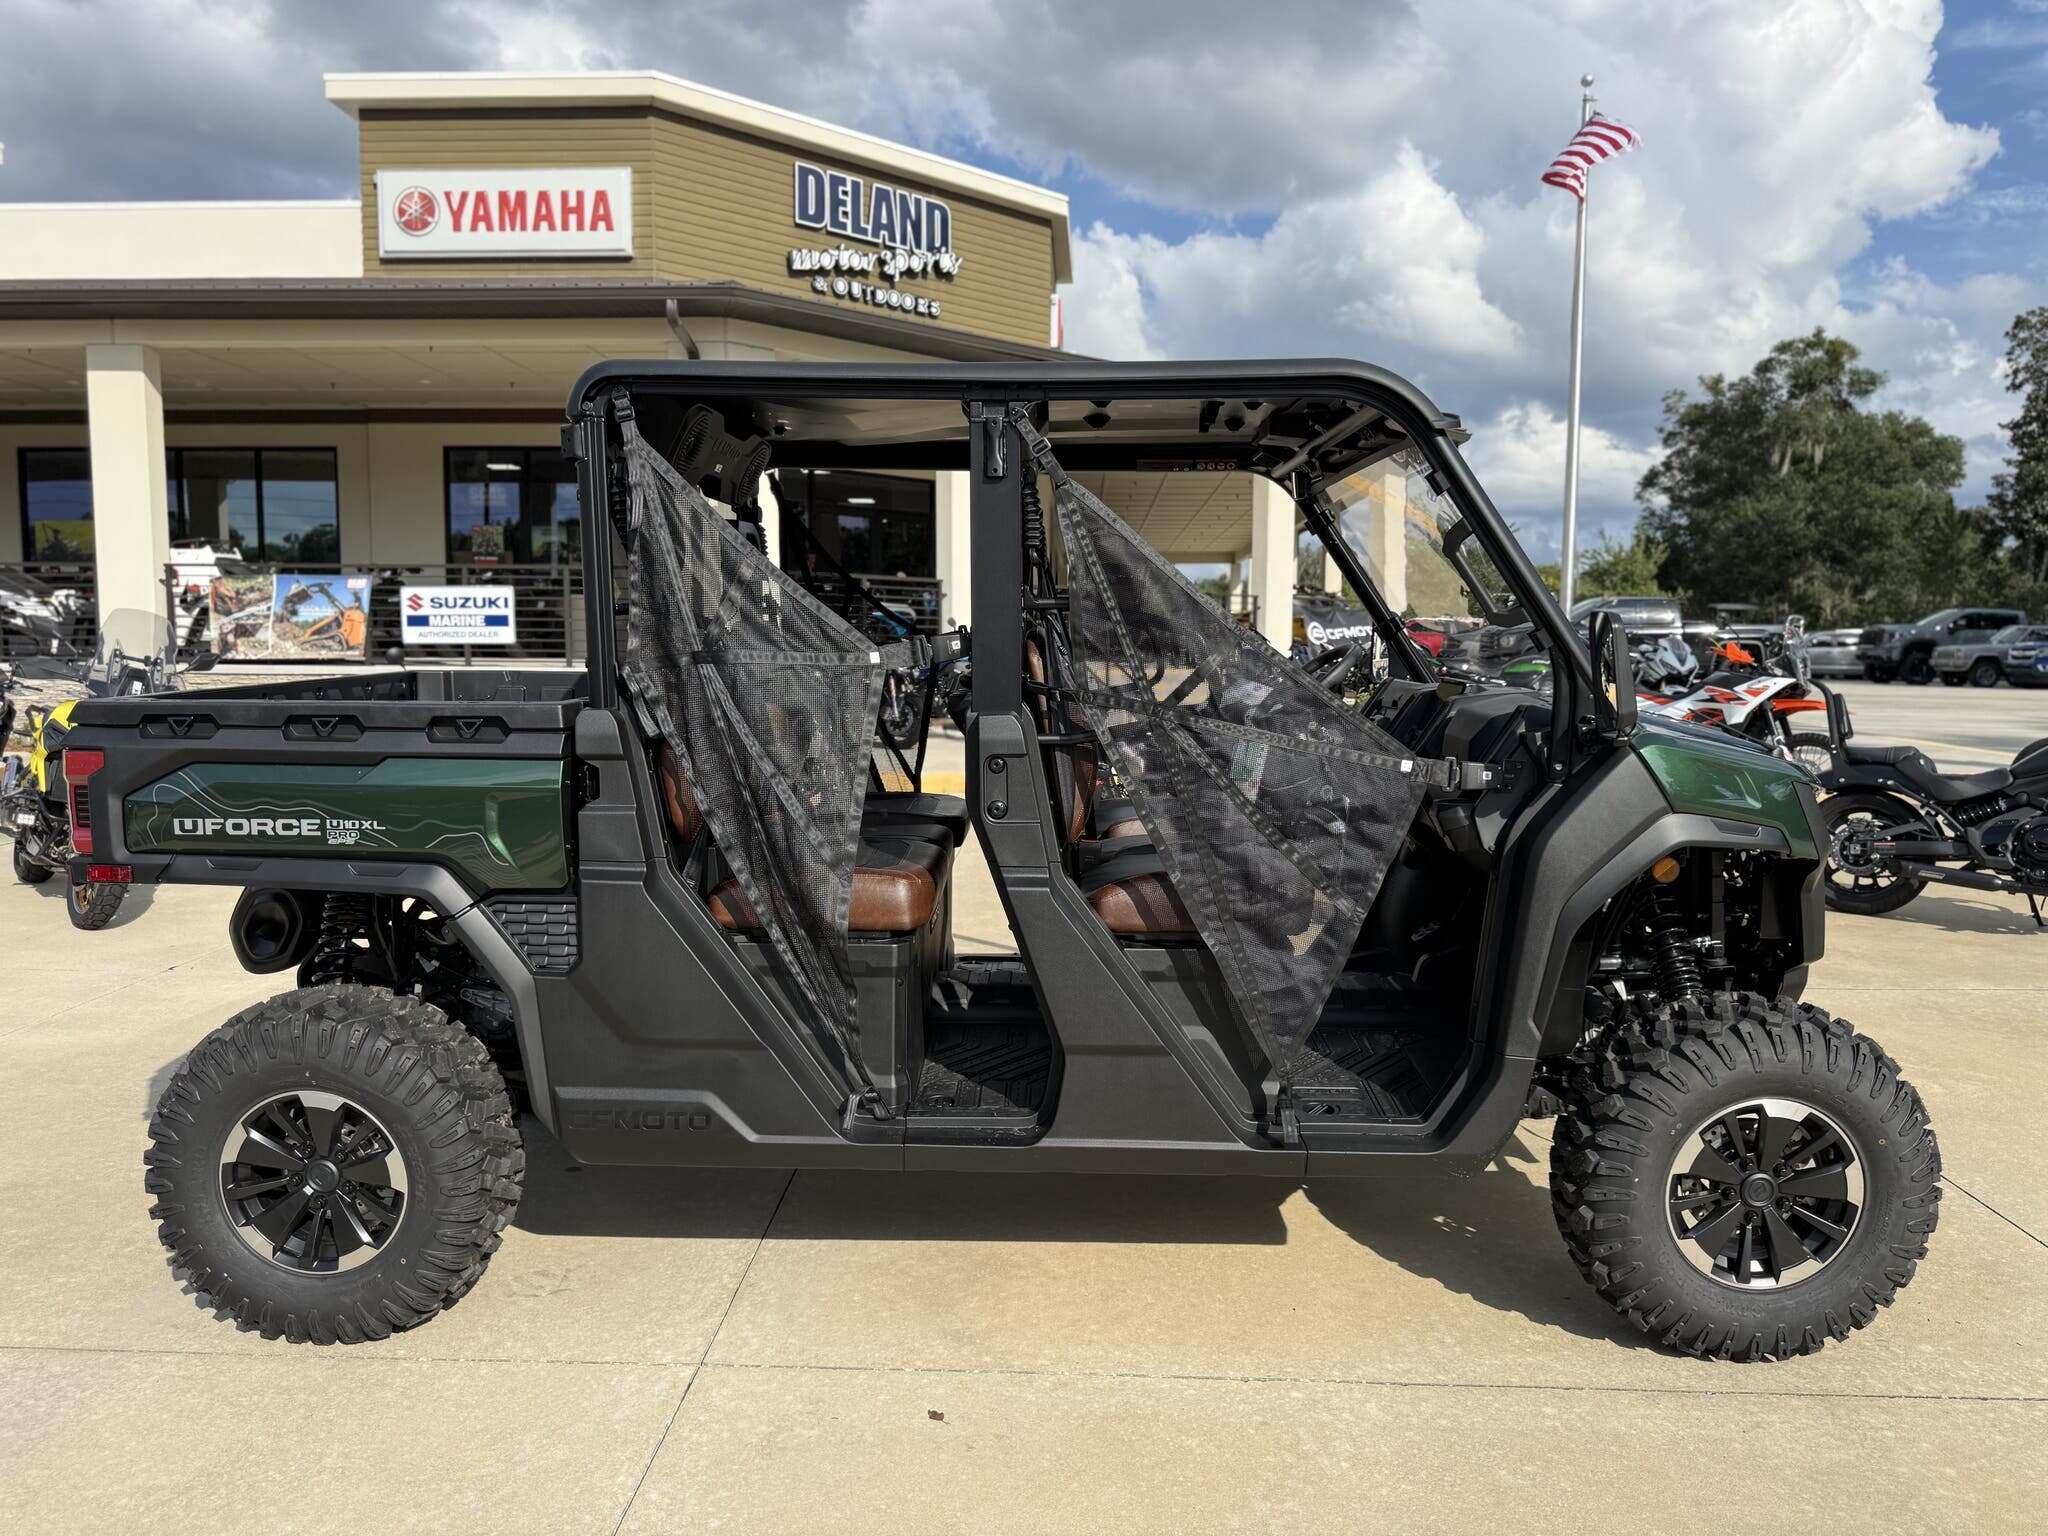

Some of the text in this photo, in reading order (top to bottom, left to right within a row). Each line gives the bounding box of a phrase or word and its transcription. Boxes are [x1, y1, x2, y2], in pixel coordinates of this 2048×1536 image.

[443, 190, 615, 232] YAMAHA
[794, 161, 952, 256] DELAND
[812, 275, 941, 317] & OUTDOORS
[430, 597, 509, 609] SUZUKI
[429, 615, 485, 627] MARINE
[1325, 625, 1373, 640] CFMOT
[173, 818, 322, 836] UFORCE
[327, 830, 360, 840] PRO
